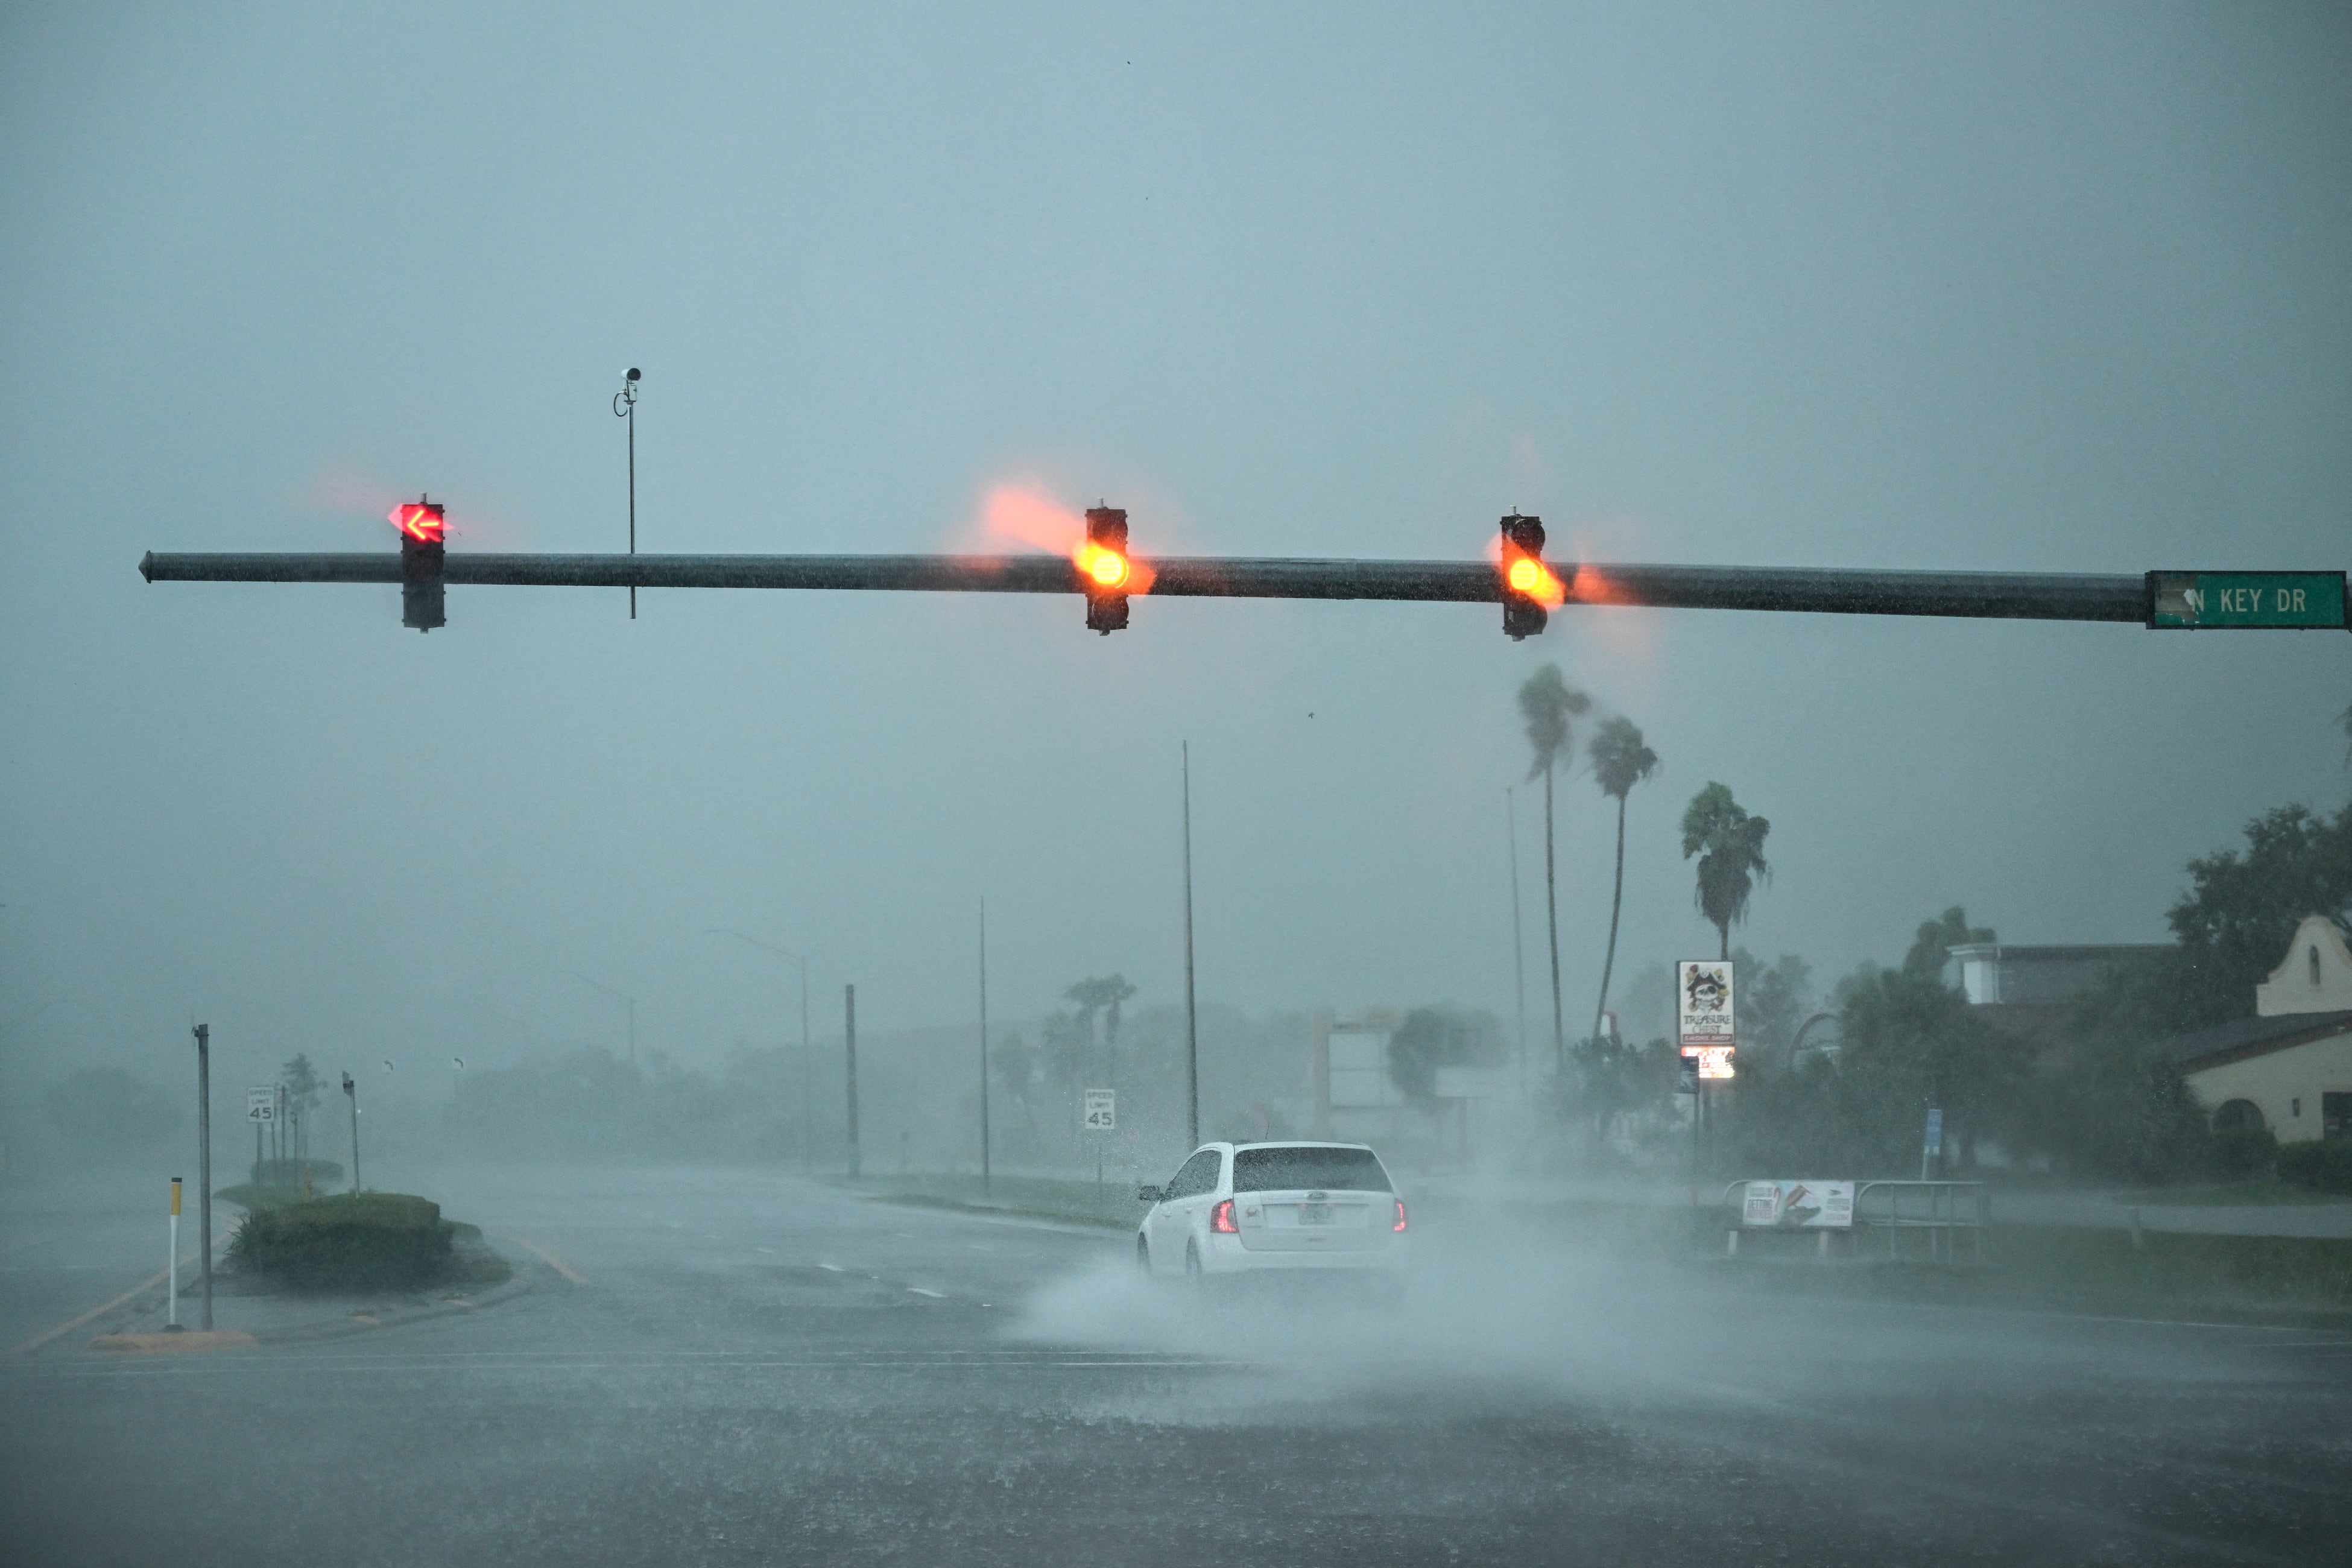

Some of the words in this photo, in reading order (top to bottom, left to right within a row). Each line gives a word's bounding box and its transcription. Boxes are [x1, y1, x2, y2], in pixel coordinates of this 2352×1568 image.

[2221, 589, 2262, 612] KEY
[2277, 589, 2306, 612] DR
[1684, 1015, 1732, 1025] TREASURE
[1692, 1025, 1721, 1034] CHEST
[250, 1107, 271, 1119] 45
[1089, 1112, 1112, 1125] 45
[1748, 1199, 1772, 1209] GETTING
